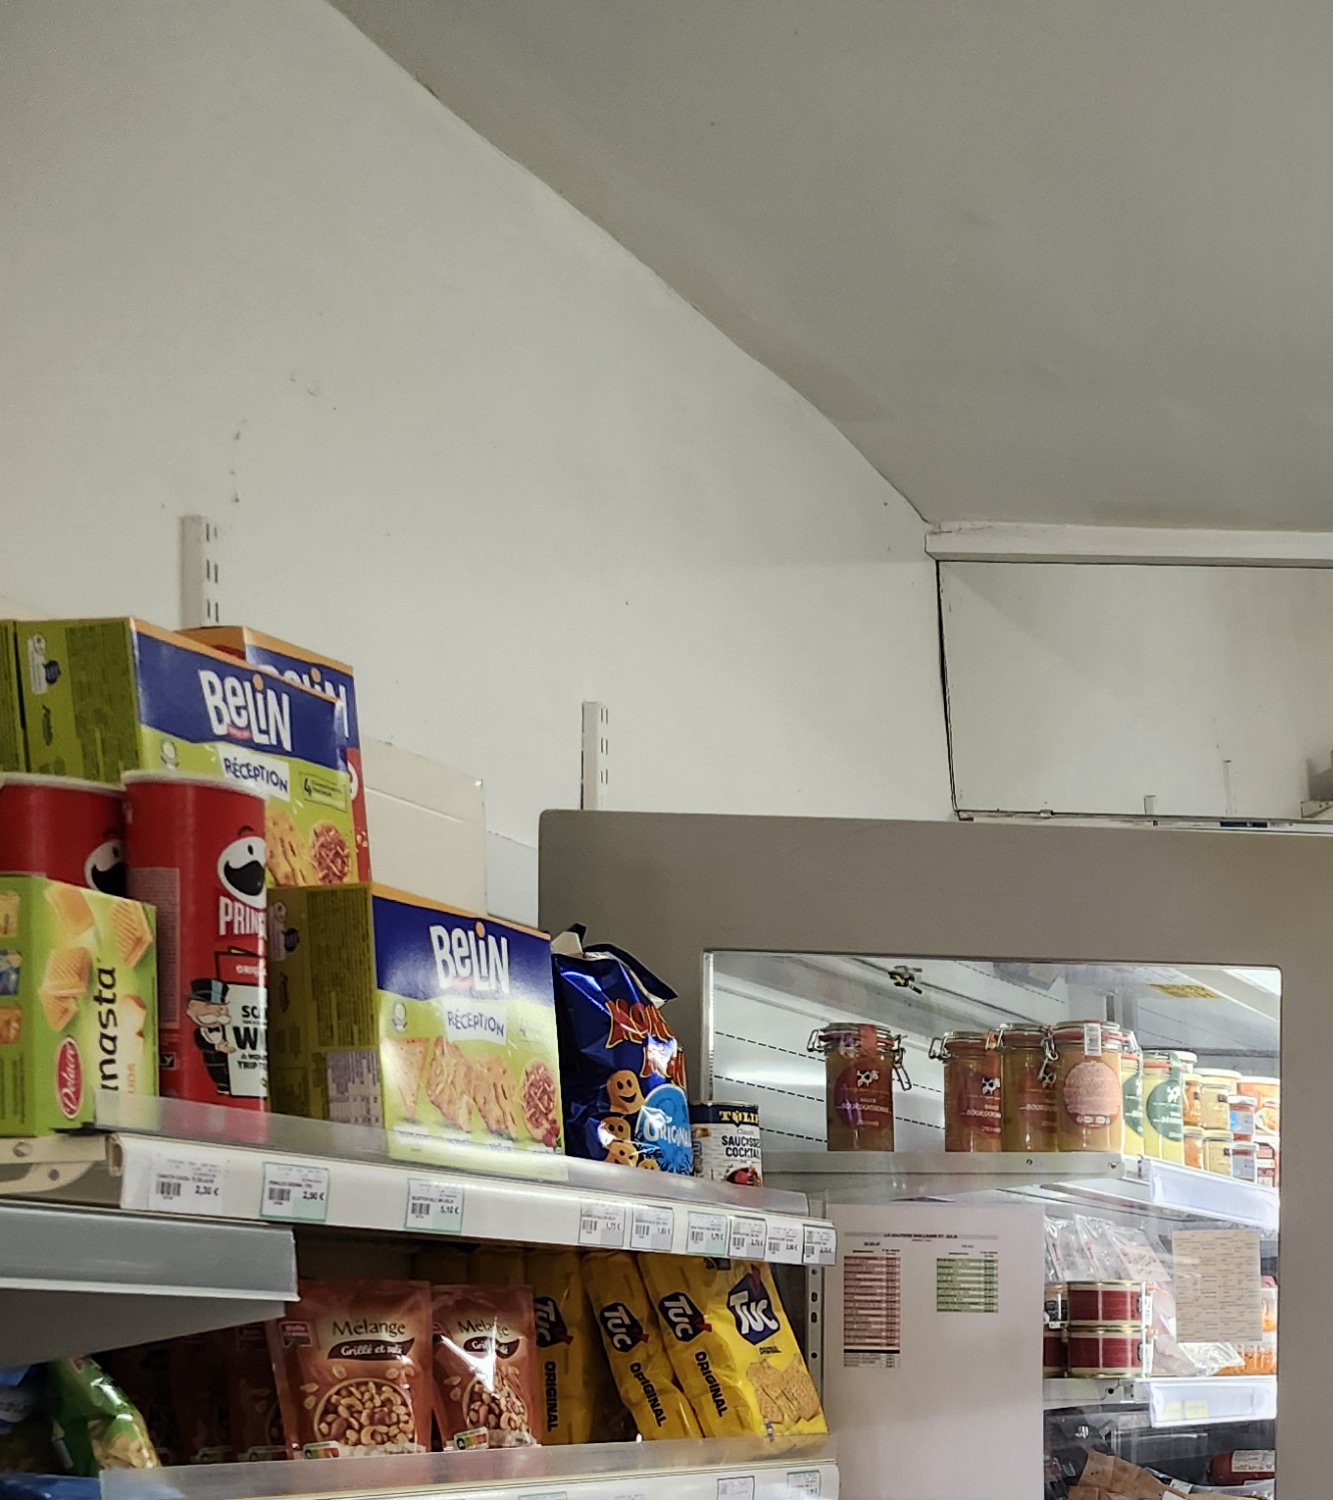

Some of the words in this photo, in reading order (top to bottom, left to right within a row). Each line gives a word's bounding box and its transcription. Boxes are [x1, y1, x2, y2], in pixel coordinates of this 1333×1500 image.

[224, 757, 289, 793] RÉCEPTION
[447, 1006, 505, 1038] RÉCEPTION
[331, 1318, 406, 1339] Mélange
[603, 1304, 633, 1351] TUC
[662, 1293, 694, 1341] TUC
[729, 1288, 781, 1337] TUC
[545, 1360, 559, 1434] ORIGINAL
[629, 1360, 665, 1428] ORIGINAL
[694, 1350, 729, 1418] ORIGINAL
